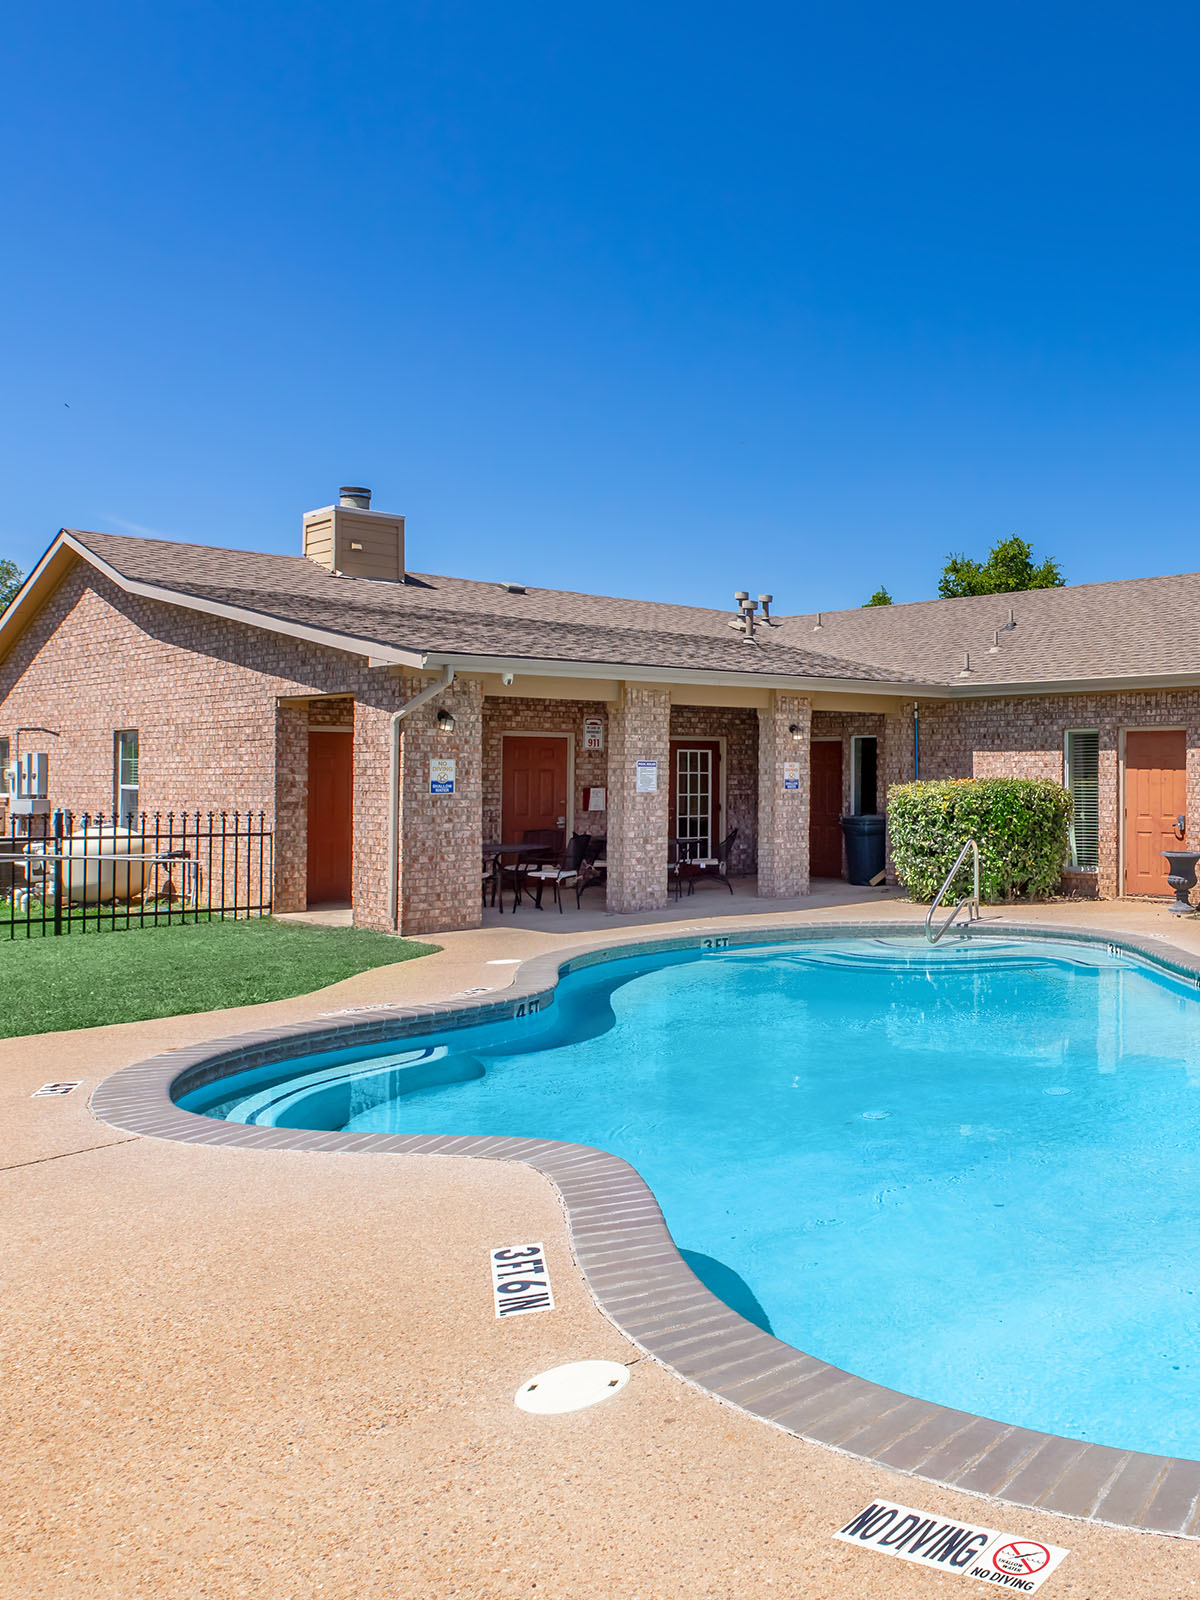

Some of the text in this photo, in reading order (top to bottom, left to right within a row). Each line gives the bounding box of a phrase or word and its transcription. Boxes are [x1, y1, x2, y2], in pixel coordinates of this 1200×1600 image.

[588, 738, 600, 748] 911
[703, 937, 729, 949] 3 FT
[516, 999, 540, 1018] 4 FT
[494, 1246, 541, 1261] 3
[496, 1280, 547, 1294] 6
[840, 1503, 989, 1568] NO DIVING
[998, 1558, 1024, 1568] SHALLOW
[1002, 1564, 1021, 1573] WATER
[970, 1566, 1035, 1591] NO DIVING
